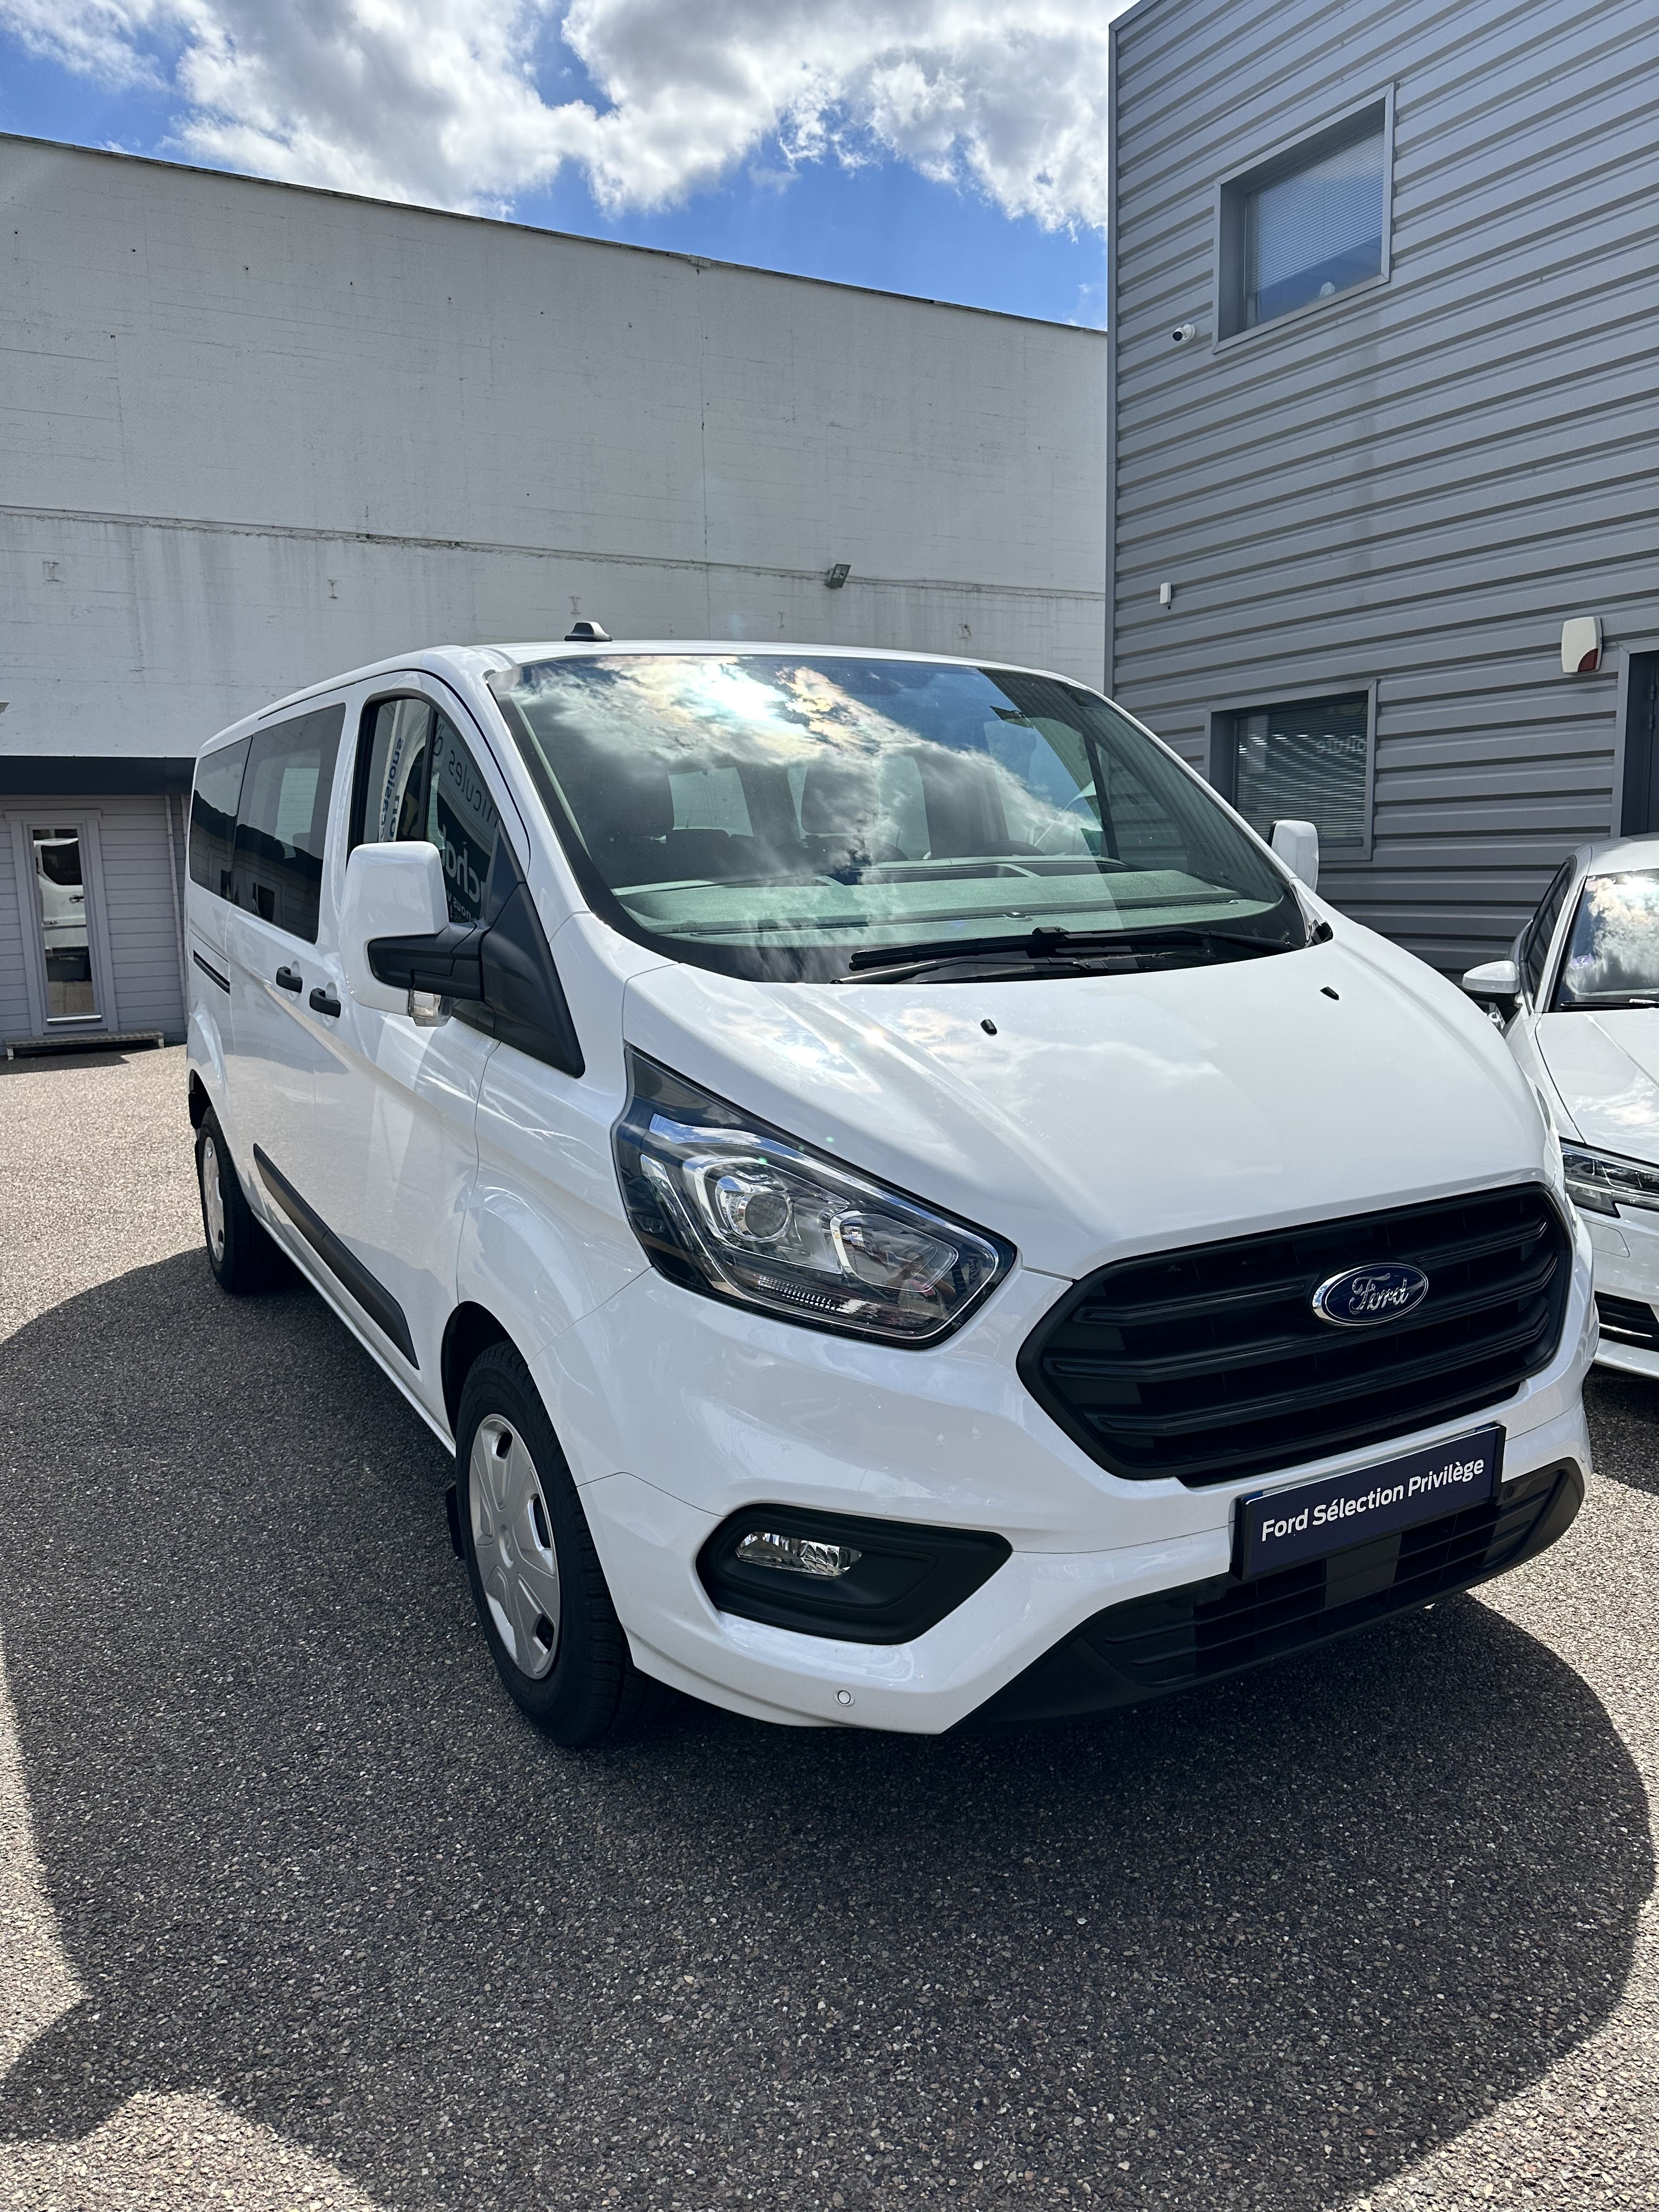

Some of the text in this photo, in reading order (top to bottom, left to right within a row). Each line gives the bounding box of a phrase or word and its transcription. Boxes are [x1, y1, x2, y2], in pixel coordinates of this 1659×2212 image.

[1348, 1272, 1409, 1315] Ford
[1262, 1459, 1485, 1542] Ford Sélection Privilège
